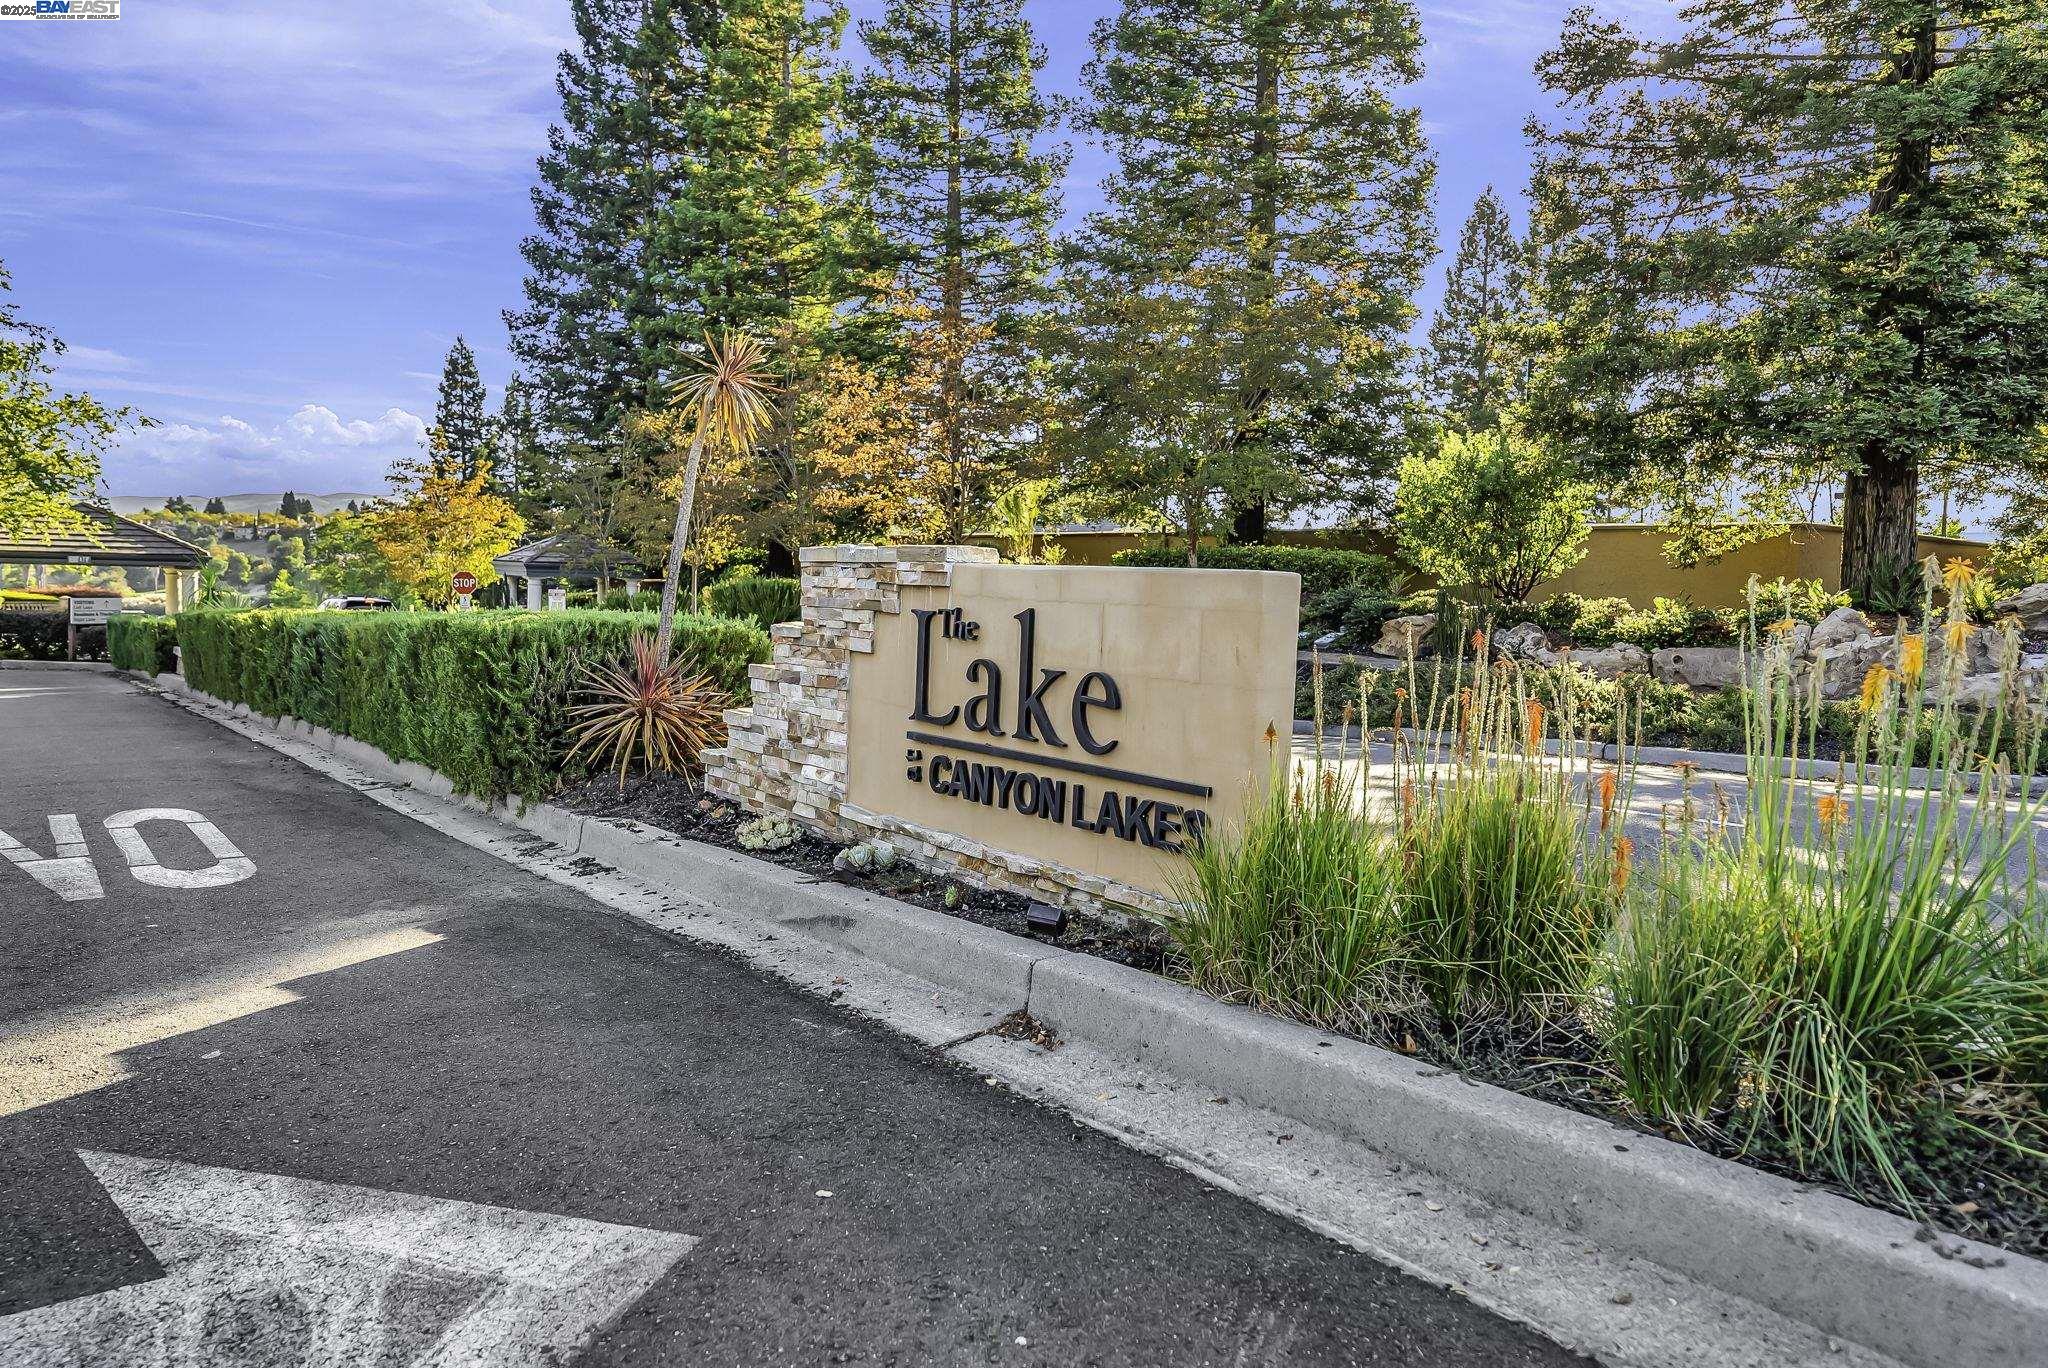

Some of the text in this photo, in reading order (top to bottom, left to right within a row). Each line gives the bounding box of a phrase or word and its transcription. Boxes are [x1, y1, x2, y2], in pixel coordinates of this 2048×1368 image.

[453, 578, 475, 588] STOP
[938, 607, 981, 641] The
[908, 607, 1122, 755] Lake
[928, 754, 1067, 824] CANYON
